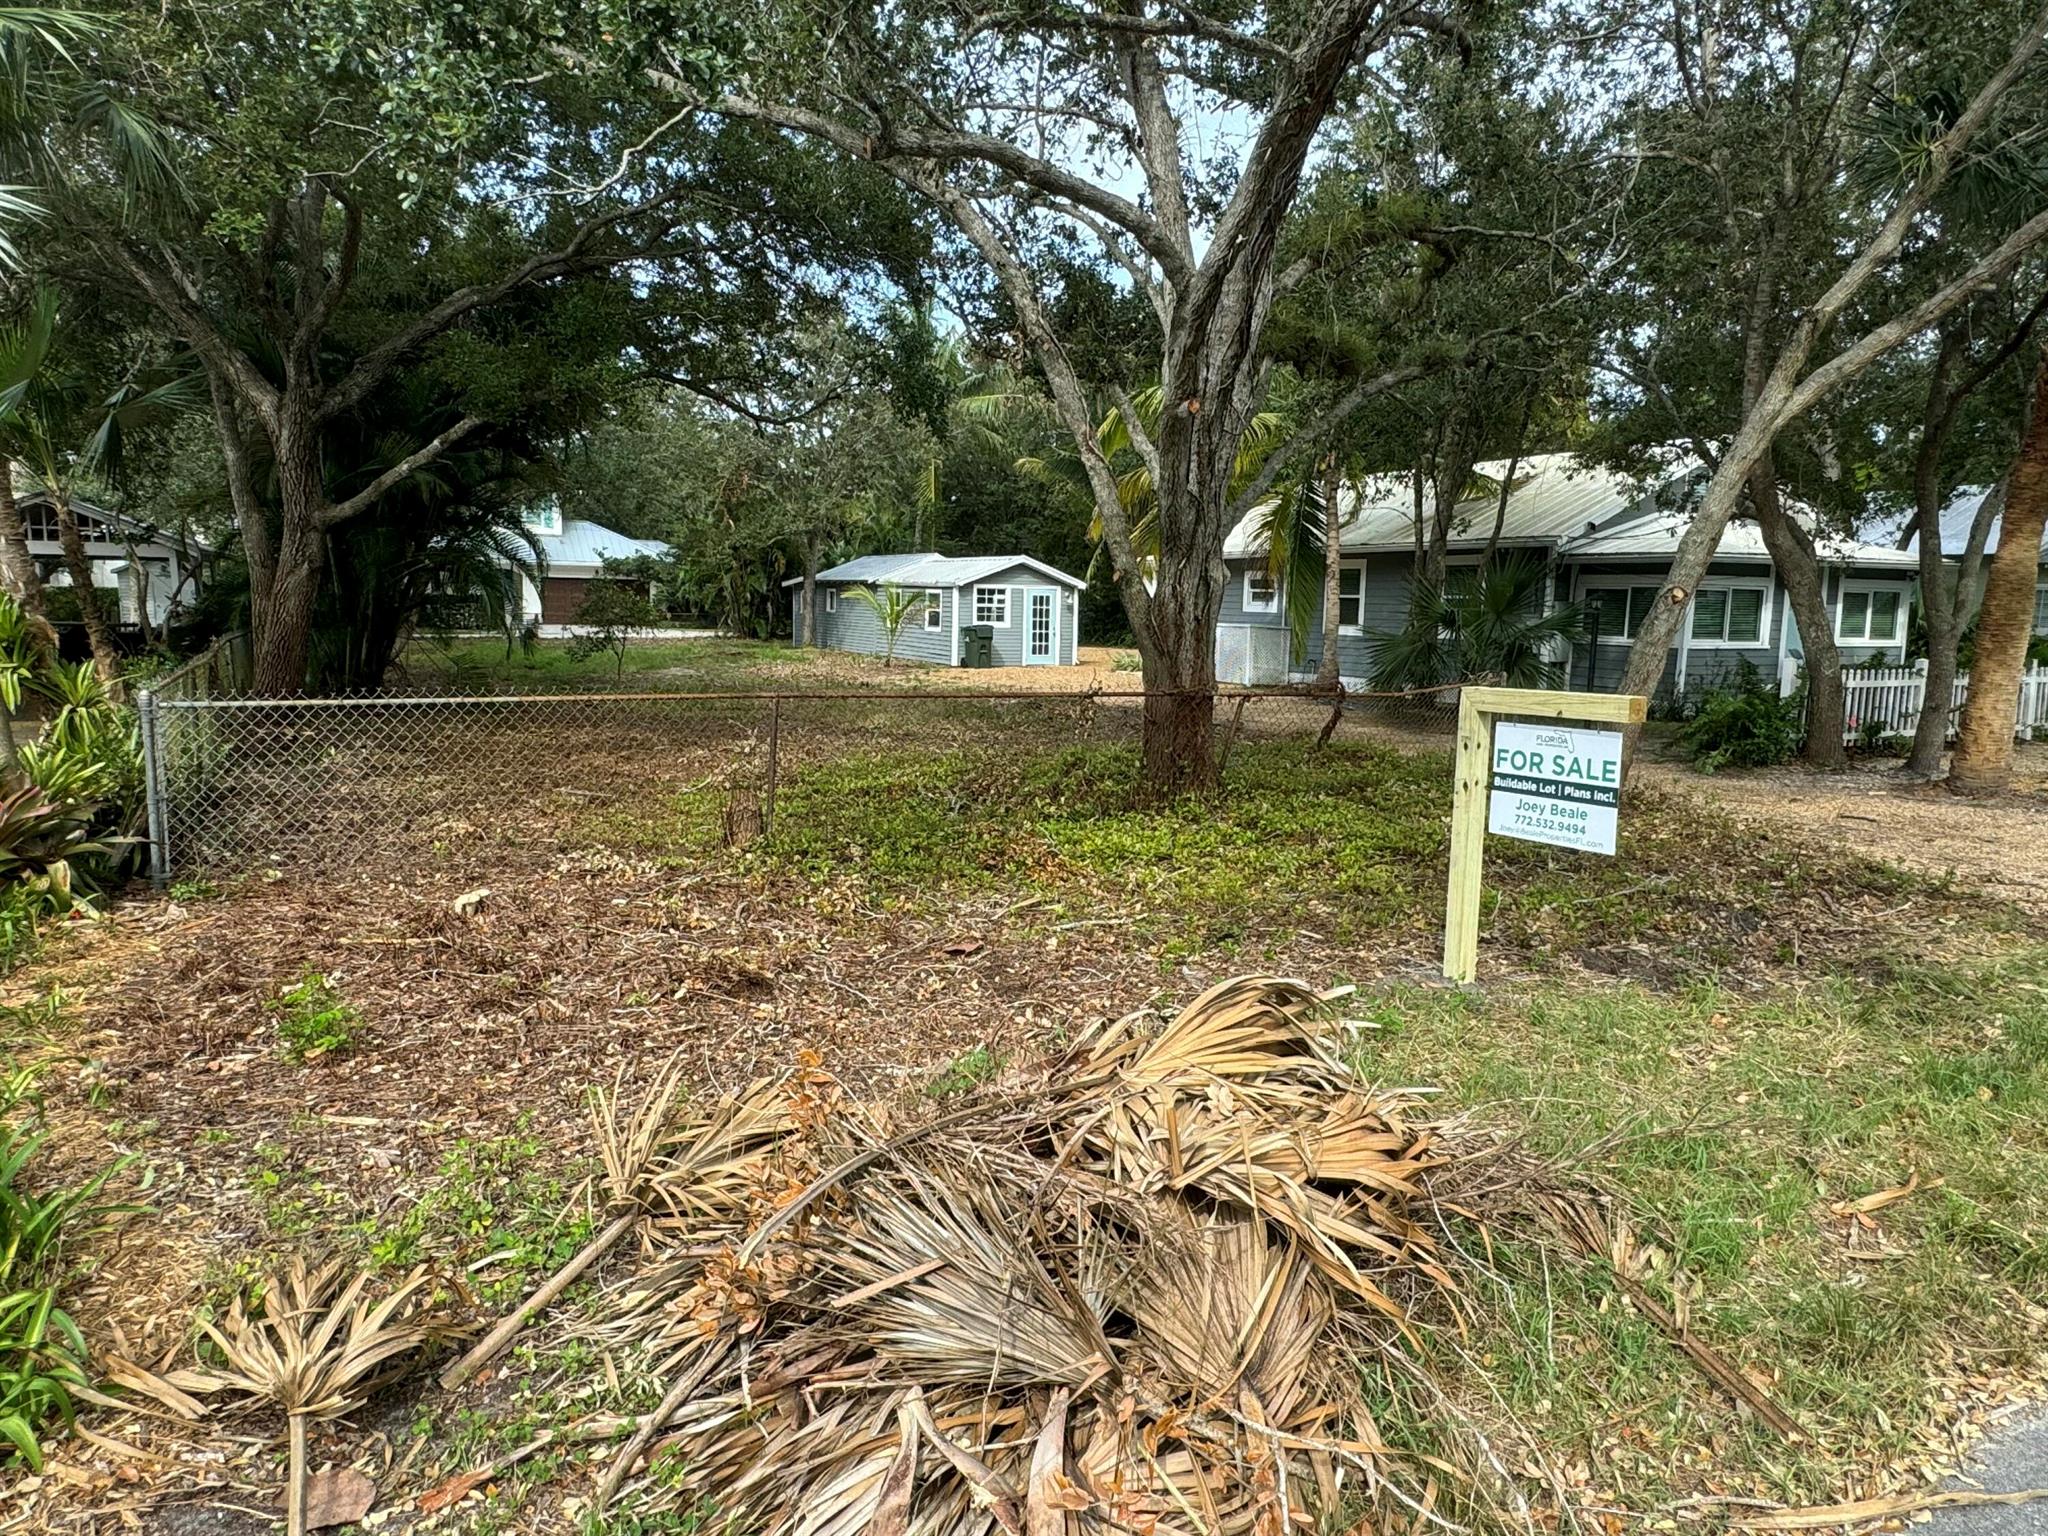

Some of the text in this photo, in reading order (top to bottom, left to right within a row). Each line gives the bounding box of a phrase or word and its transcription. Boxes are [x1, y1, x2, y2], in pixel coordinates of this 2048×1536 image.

[1536, 735, 1568, 744] FLORIDA
[1497, 749, 1617, 782] FOR SALE
[1494, 777, 1536, 791] Buildable
[1540, 785, 1556, 795] Lot
[1565, 787, 1591, 799] Plans
[1594, 791, 1615, 803] Incl.
[1516, 799, 1588, 820] Joey Beale
[1515, 815, 1586, 835] 772.532.9494
